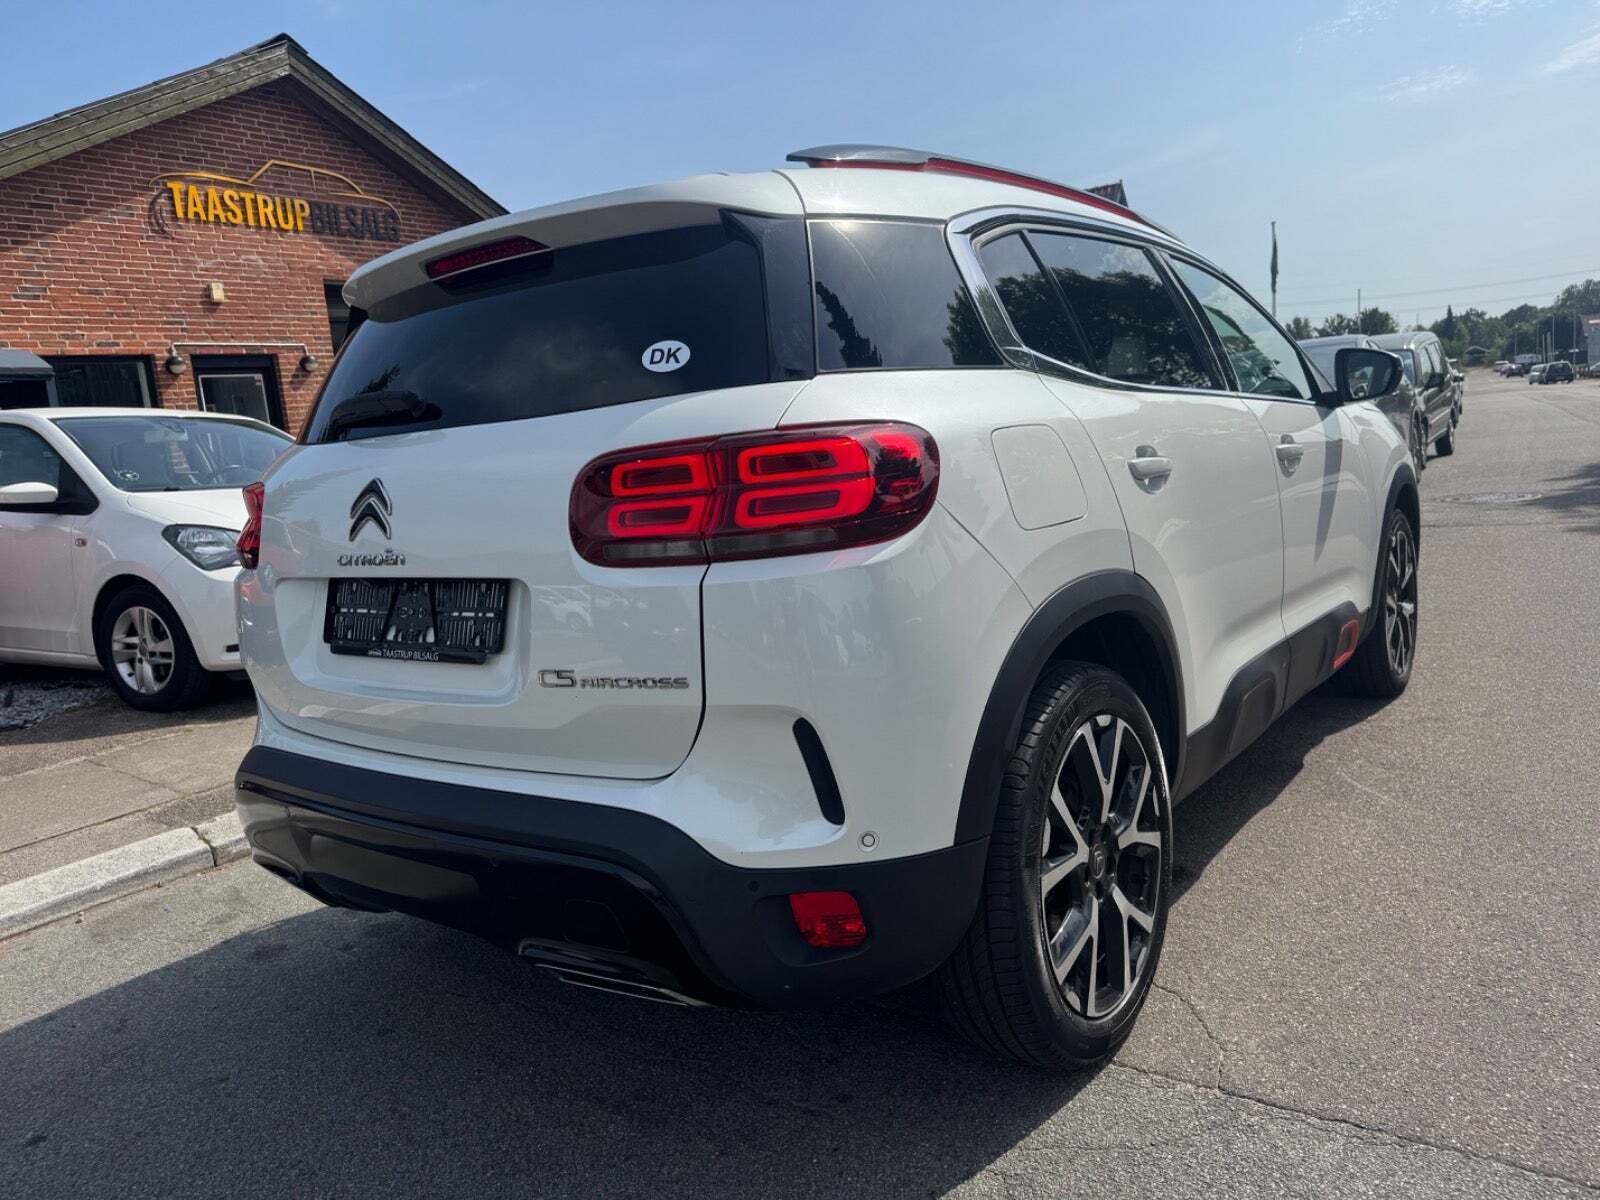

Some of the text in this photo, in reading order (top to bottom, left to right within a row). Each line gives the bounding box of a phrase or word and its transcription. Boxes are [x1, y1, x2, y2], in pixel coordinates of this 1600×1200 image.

[166, 180, 400, 242] TAASTRUP BILSALG
[649, 346, 683, 365] DK
[382, 648, 440, 661] TAASTRUP BILSALG
[538, 669, 690, 690] C5 AIRCROSS
